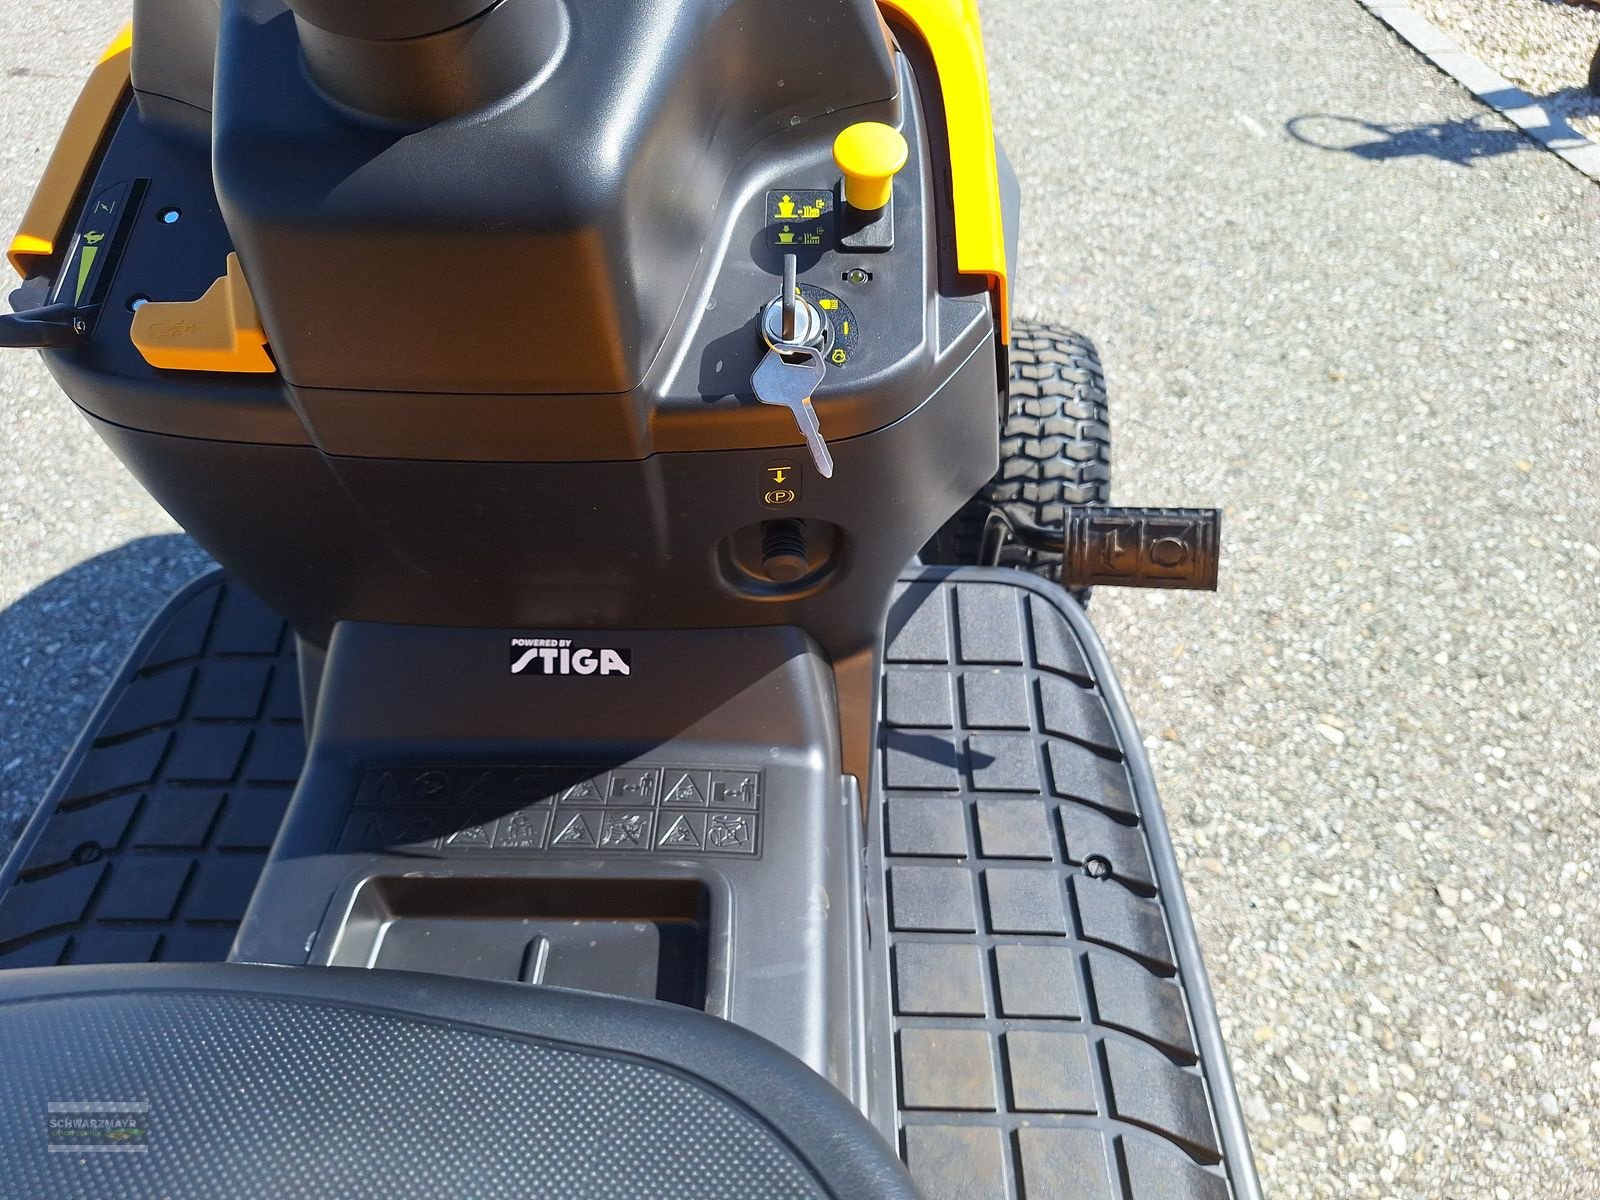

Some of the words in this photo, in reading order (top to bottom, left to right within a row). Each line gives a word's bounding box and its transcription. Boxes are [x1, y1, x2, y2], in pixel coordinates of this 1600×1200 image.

[511, 638, 558, 647] POWERED
[558, 639, 572, 648] BY
[511, 648, 630, 675] STIGA
